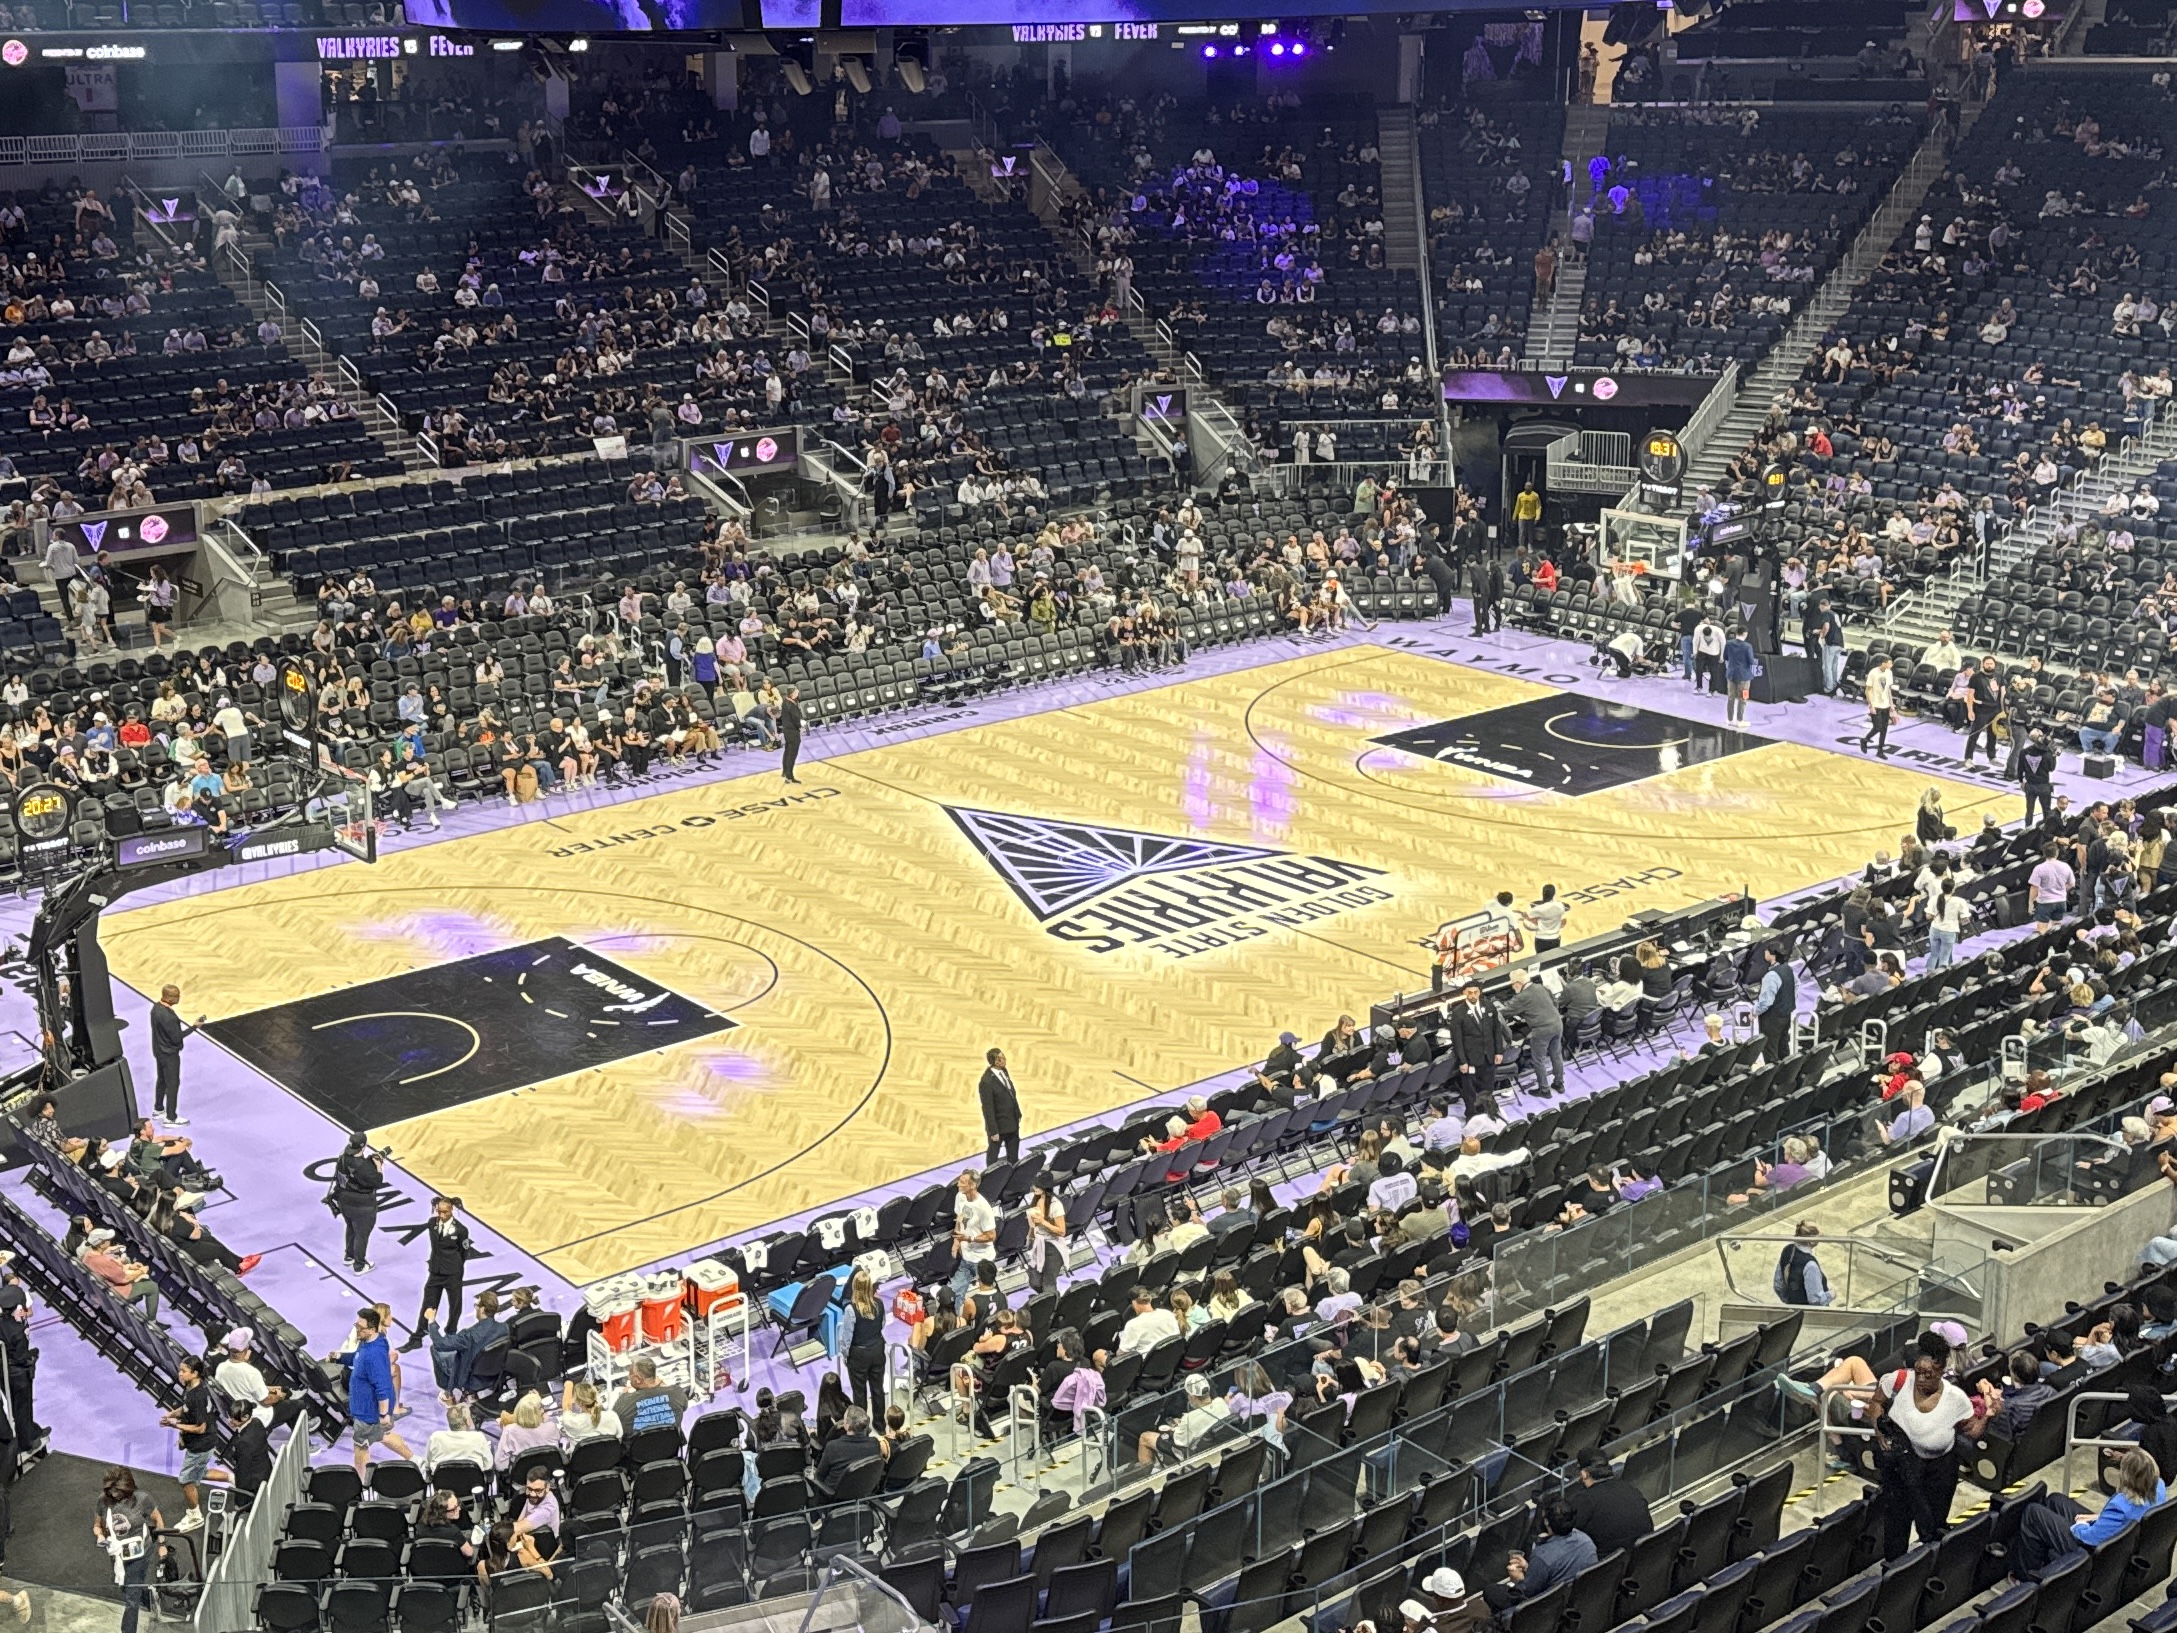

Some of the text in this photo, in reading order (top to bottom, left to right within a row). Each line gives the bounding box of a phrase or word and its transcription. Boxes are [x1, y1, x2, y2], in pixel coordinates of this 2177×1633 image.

[1012, 25, 1085, 42] VALKYRIES
[1114, 24, 1158, 39] FEVER
[86, 44, 146, 59] coinbase
[316, 36, 399, 58] VALKYRIES
[1386, 637, 1580, 684] WAYMO
[23, 795, 61, 817] 20:27
[551, 787, 841, 859] CHASE CENTER
[136, 838, 187, 856] coinbase
[241, 839, 299, 860] @VALKYRIES
[1562, 866, 1684, 905] CHASE
[1046, 855, 1390, 954] VALKYRIES
[1149, 885, 1394, 959] GOLDEN STATE
